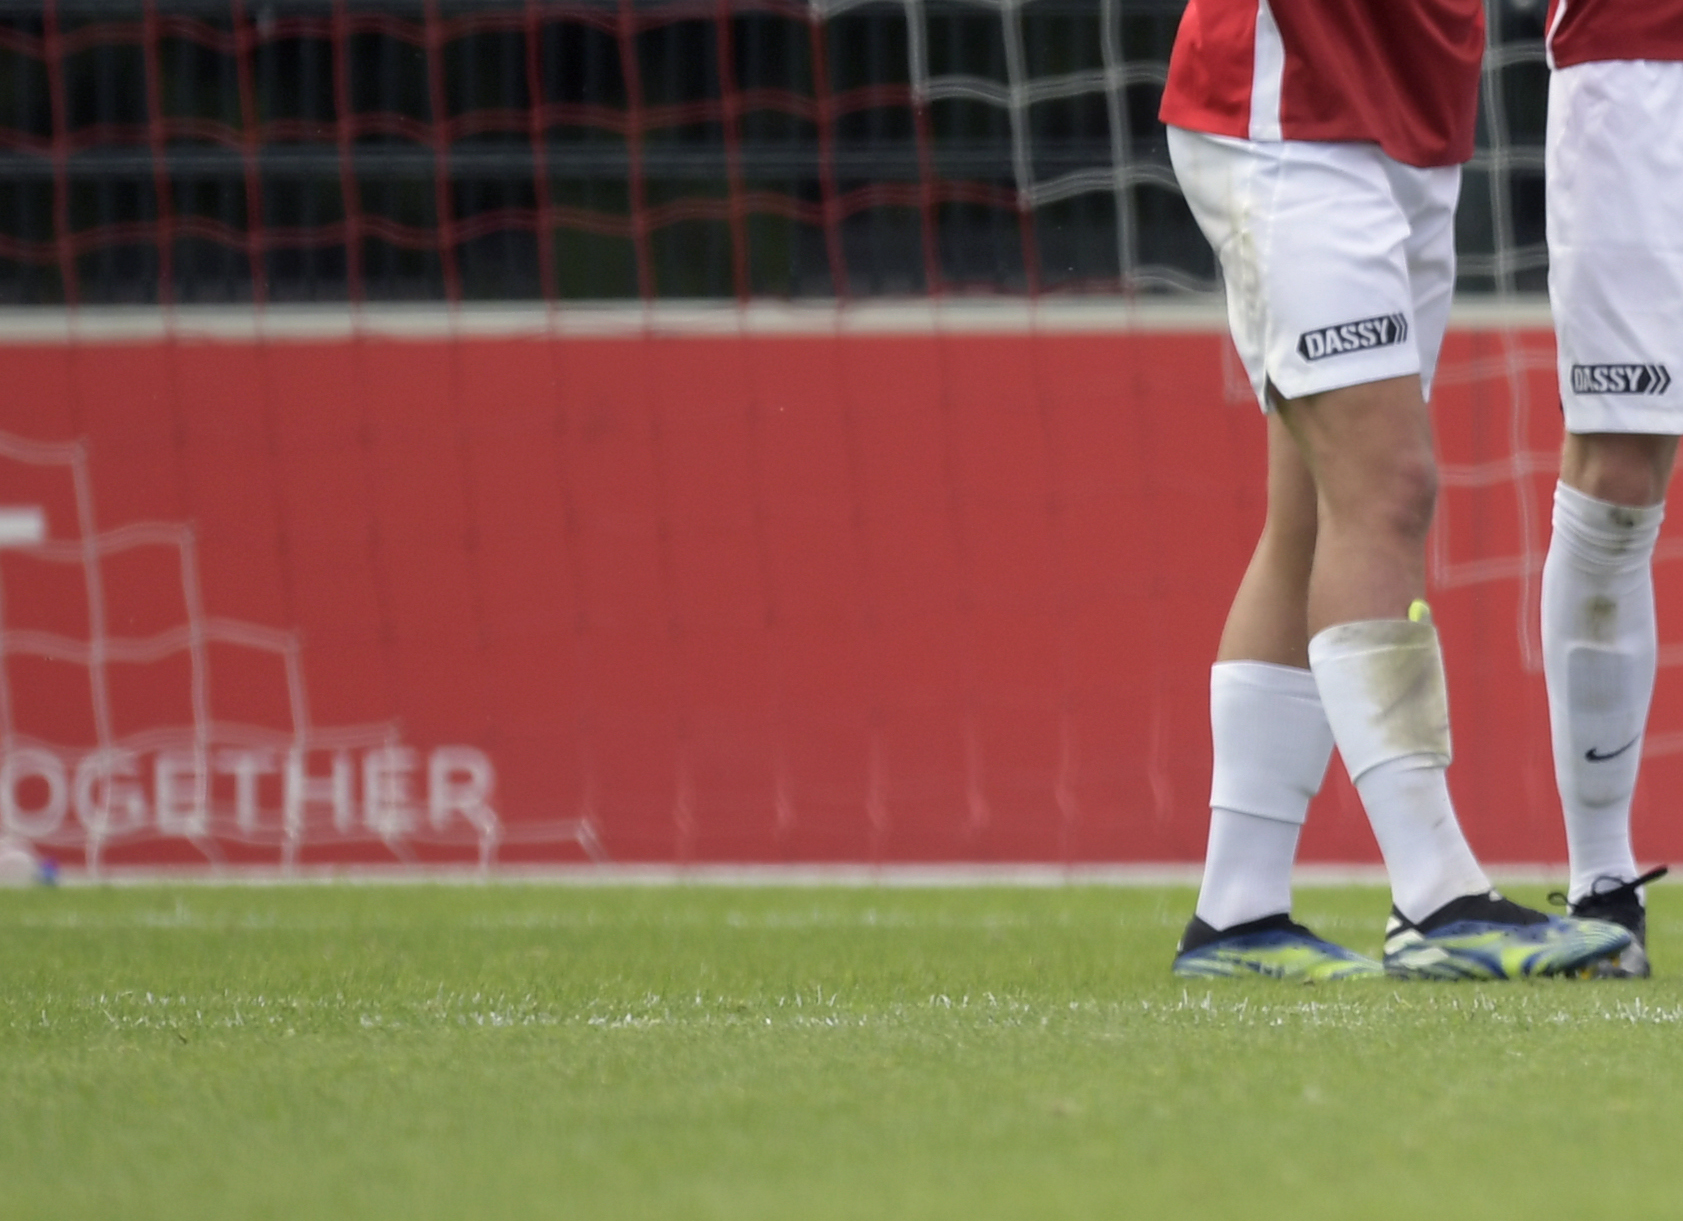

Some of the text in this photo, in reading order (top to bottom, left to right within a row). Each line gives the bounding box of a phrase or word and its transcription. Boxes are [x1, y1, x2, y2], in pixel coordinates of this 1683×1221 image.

[1304, 317, 1389, 359] DASSY
[1573, 365, 1644, 392] DASSY
[2, 745, 497, 836] OGETHER
